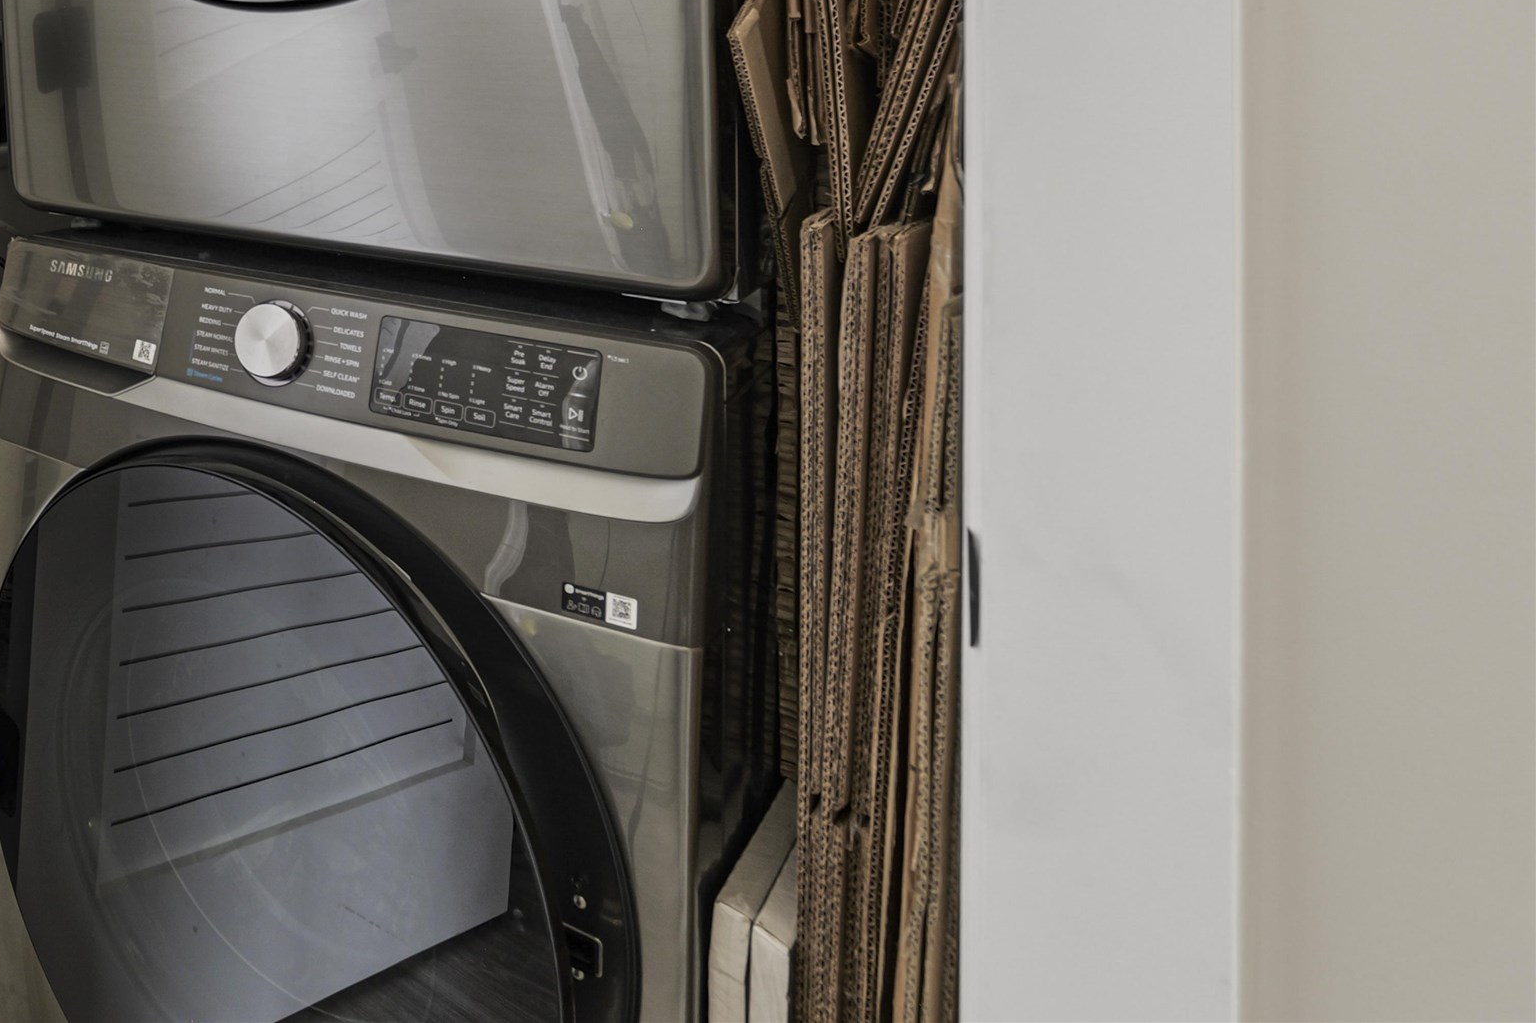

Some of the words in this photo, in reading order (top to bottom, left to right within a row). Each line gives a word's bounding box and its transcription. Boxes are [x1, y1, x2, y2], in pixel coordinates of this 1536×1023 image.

[50, 259, 113, 282] SAMSUNG
[204, 287, 226, 296] NORMAL
[201, 304, 218, 313] HEAVY
[219, 306, 232, 314] DUTY
[331, 308, 348, 317] QUICK
[349, 311, 367, 320] WASH
[199, 316, 221, 326] BEDDING
[196, 330, 212, 338] STEAM
[212, 333, 233, 343] NORMAL
[333, 326, 364, 338] DELICATES
[194, 344, 210, 352] STEAM
[210, 347, 228, 356] WHITES
[339, 342, 362, 353] TOWELS
[513, 349, 525, 358] Pre
[510, 357, 526, 365] Soak
[538, 354, 557, 364] Delay
[192, 358, 208, 366] STEAM
[208, 361, 229, 371] SANITIZE
[540, 362, 553, 370] End
[323, 370, 337, 378] SELF
[506, 376, 525, 385] Super
[505, 383, 525, 393] Speed
[534, 381, 555, 391] Alarm
[316, 384, 356, 399] DOWNLOADED
[538, 389, 550, 397] Off
[409, 398, 426, 409] Rinse
[503, 403, 523, 413] Smart
[440, 405, 455, 415] Spin
[531, 409, 552, 418] Smart
[473, 412, 486, 421] Soil
[505, 411, 520, 420] Care
[529, 416, 553, 427] Control
